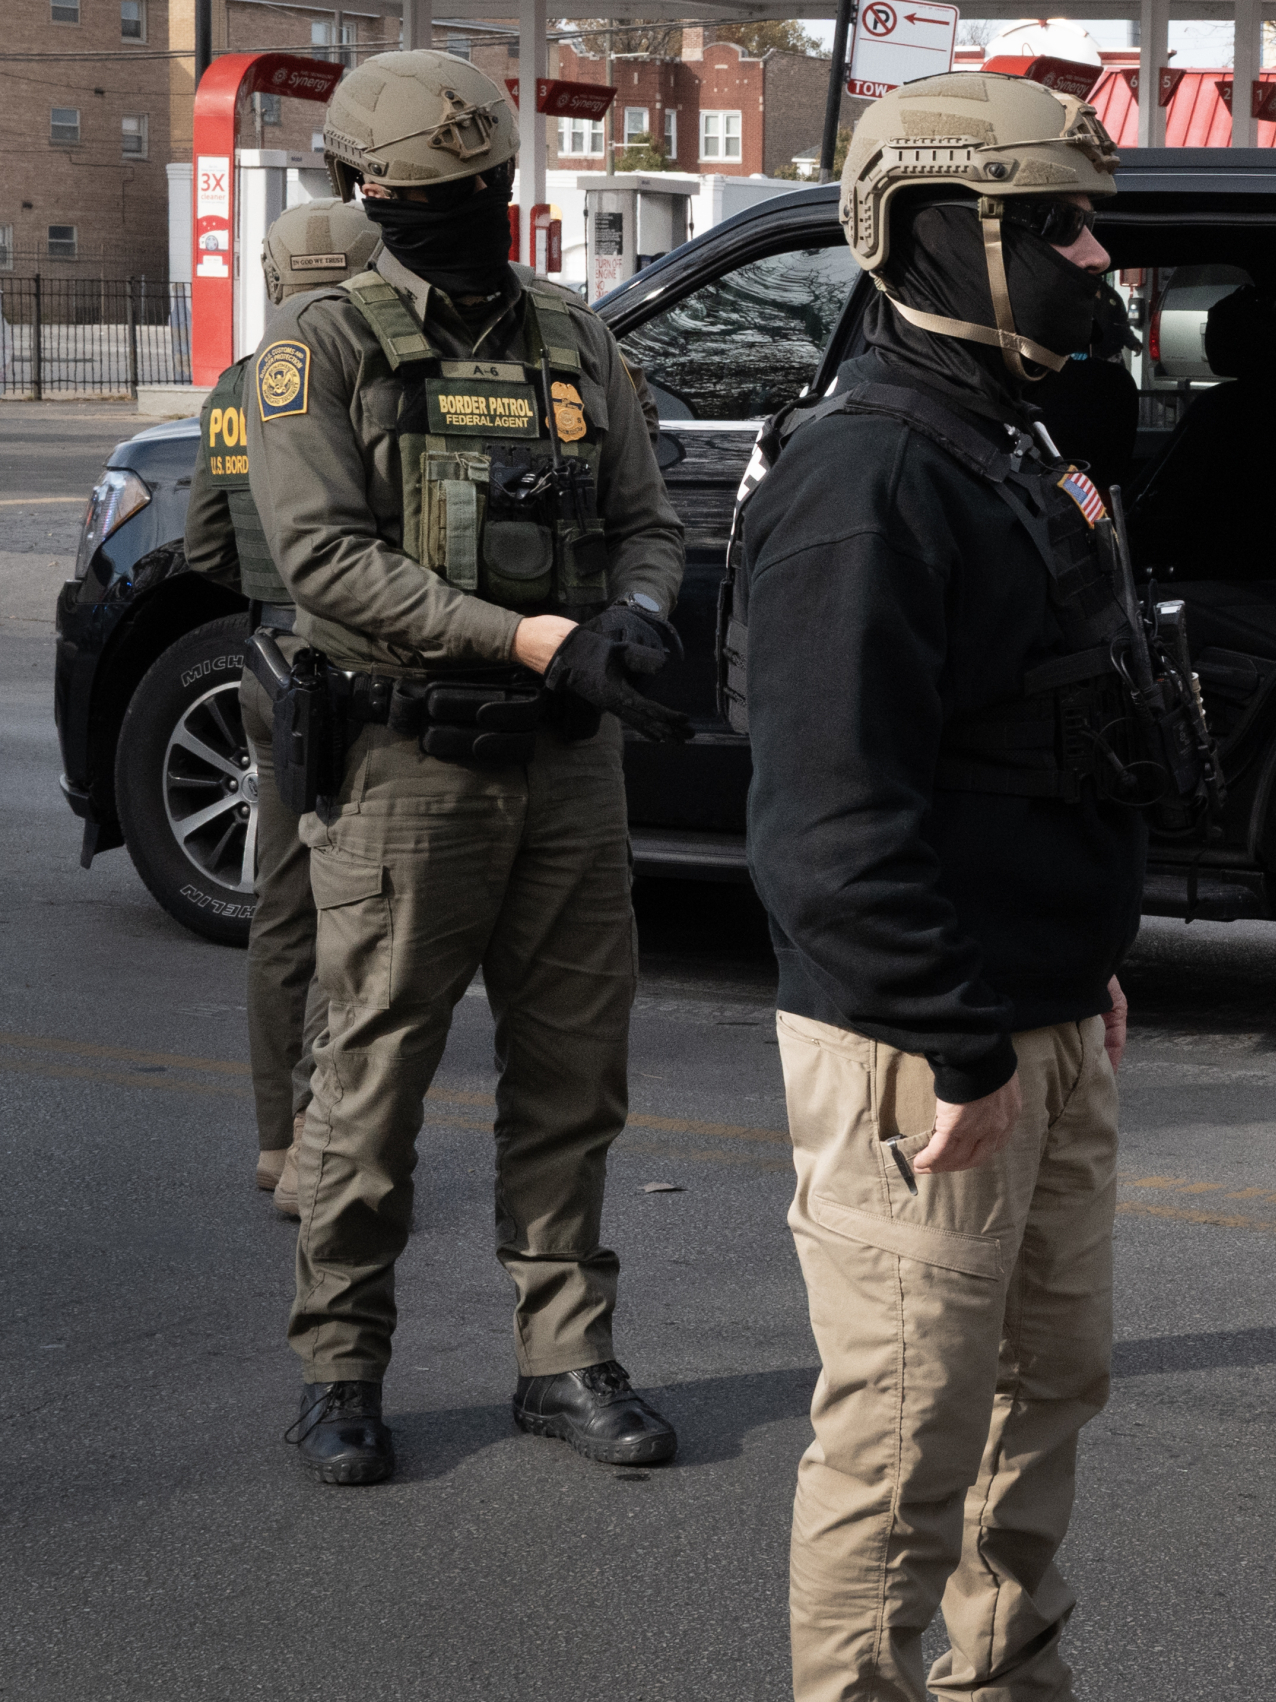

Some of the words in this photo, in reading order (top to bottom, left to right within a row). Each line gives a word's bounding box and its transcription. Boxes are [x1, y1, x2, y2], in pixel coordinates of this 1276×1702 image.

[288, 72, 332, 93] Synergy
[853, 80, 888, 97] TOW
[1054, 76, 1090, 97] Synergy
[1130, 75, 1138, 88] 6
[1162, 75, 1171, 88] 5
[511, 85, 519, 96] 4
[539, 85, 547, 97] 3
[1223, 87, 1231, 100] 2
[1256, 89, 1263, 101] 1
[569, 95, 606, 112] Synergy
[200, 172, 226, 192] 3X
[200, 192, 226, 201] cleaner
[473, 365, 499, 377] A-6
[438, 394, 488, 414] BORDER
[488, 397, 534, 417] PATROL
[446, 414, 493, 426] FEDERAL
[494, 416, 529, 428] AGENT
[210, 455, 225, 475] U.S.
[225, 455, 249, 475] BORD
[180, 654, 245, 688] MICH
